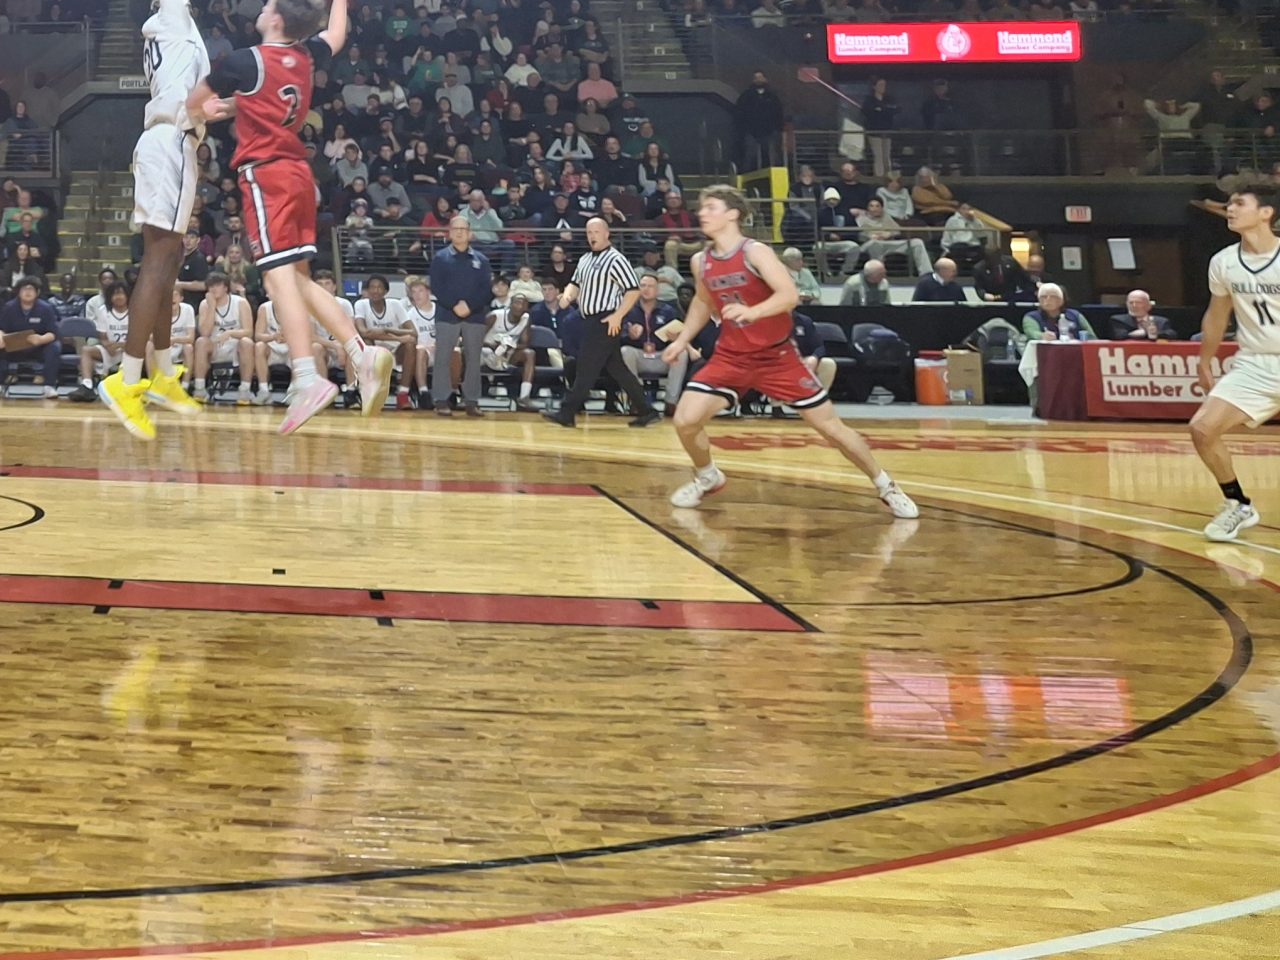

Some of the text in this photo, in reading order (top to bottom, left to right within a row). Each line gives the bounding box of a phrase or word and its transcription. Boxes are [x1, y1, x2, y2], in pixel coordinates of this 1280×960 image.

[834, 32, 908, 46] Hammond
[997, 30, 1072, 44] Hammond
[278, 84, 301, 128] 2
[1252, 300, 1275, 325] 11
[1108, 381, 1183, 397] Lumber
